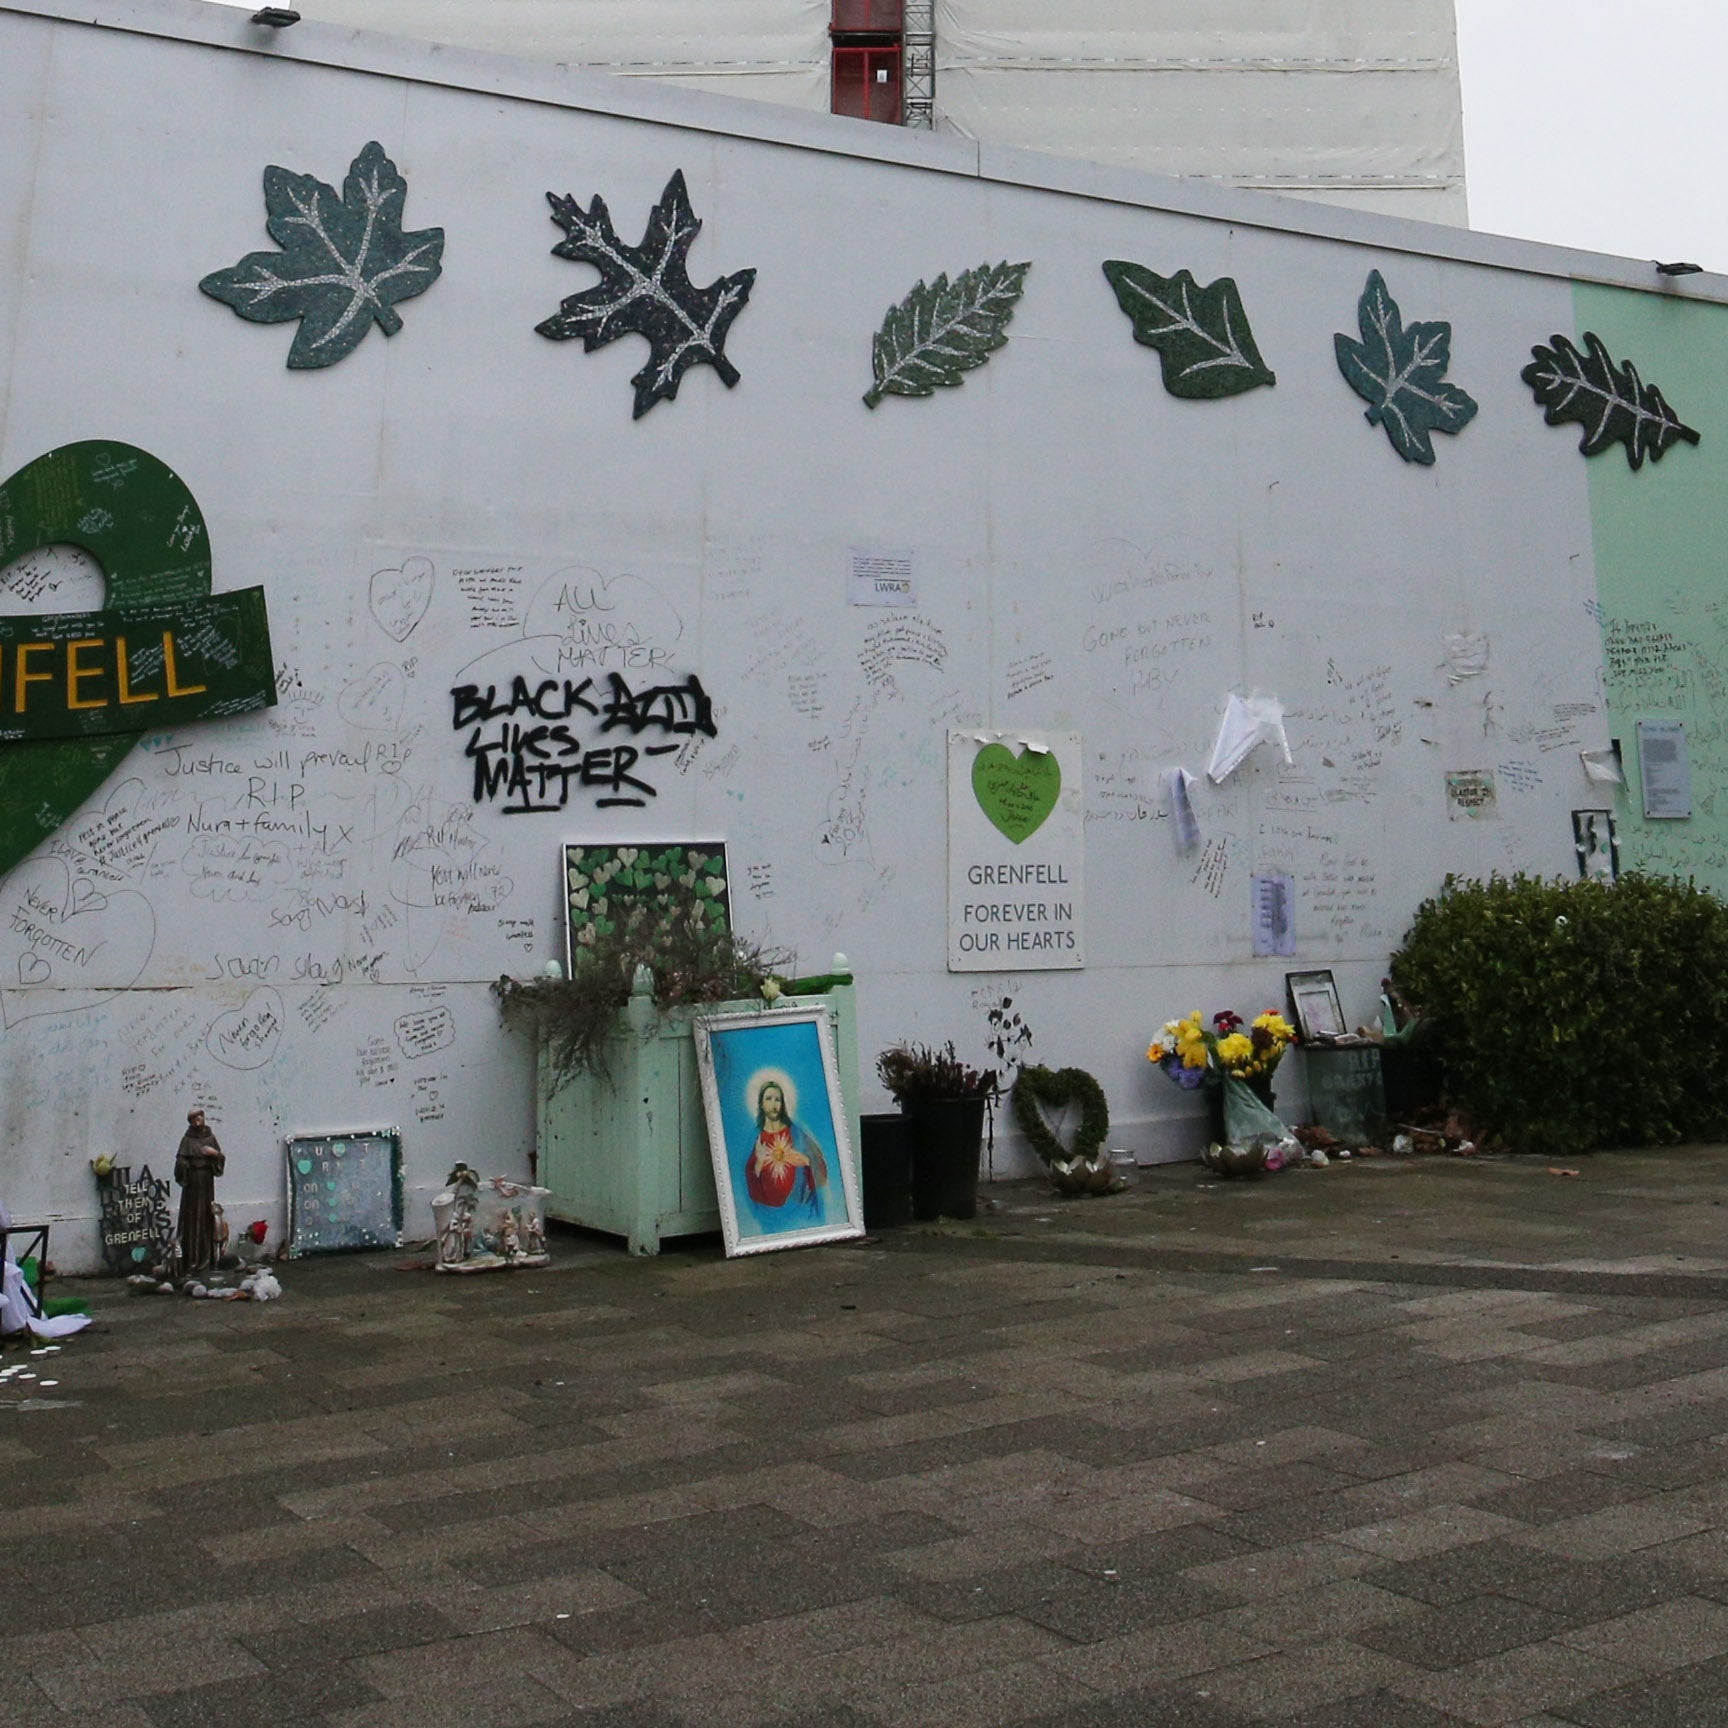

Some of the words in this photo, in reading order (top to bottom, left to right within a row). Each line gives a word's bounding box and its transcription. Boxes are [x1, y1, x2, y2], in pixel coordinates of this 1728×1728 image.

[449, 674, 599, 731] BLACK
[465, 722, 581, 759] LIVES
[153, 744, 245, 776] Justice
[253, 751, 291, 771] will
[300, 741, 372, 779] prevail
[471, 743, 658, 806] MATTER
[247, 776, 306, 812] RIP
[967, 864, 1069, 886] GRENFELL
[23, 883, 59, 924] NEVER
[963, 903, 1049, 923] FOREVER
[1054, 902, 1073, 921] IN
[8, 904, 110, 968] FORGOTTEN
[958, 933, 1001, 953] OUR
[1006, 930, 1077, 952] HEARTS
[123, 1181, 149, 1195] TELL
[117, 1196, 155, 1214] THEM
[126, 1212, 142, 1224] OF
[105, 1226, 161, 1246] GRENFELL
